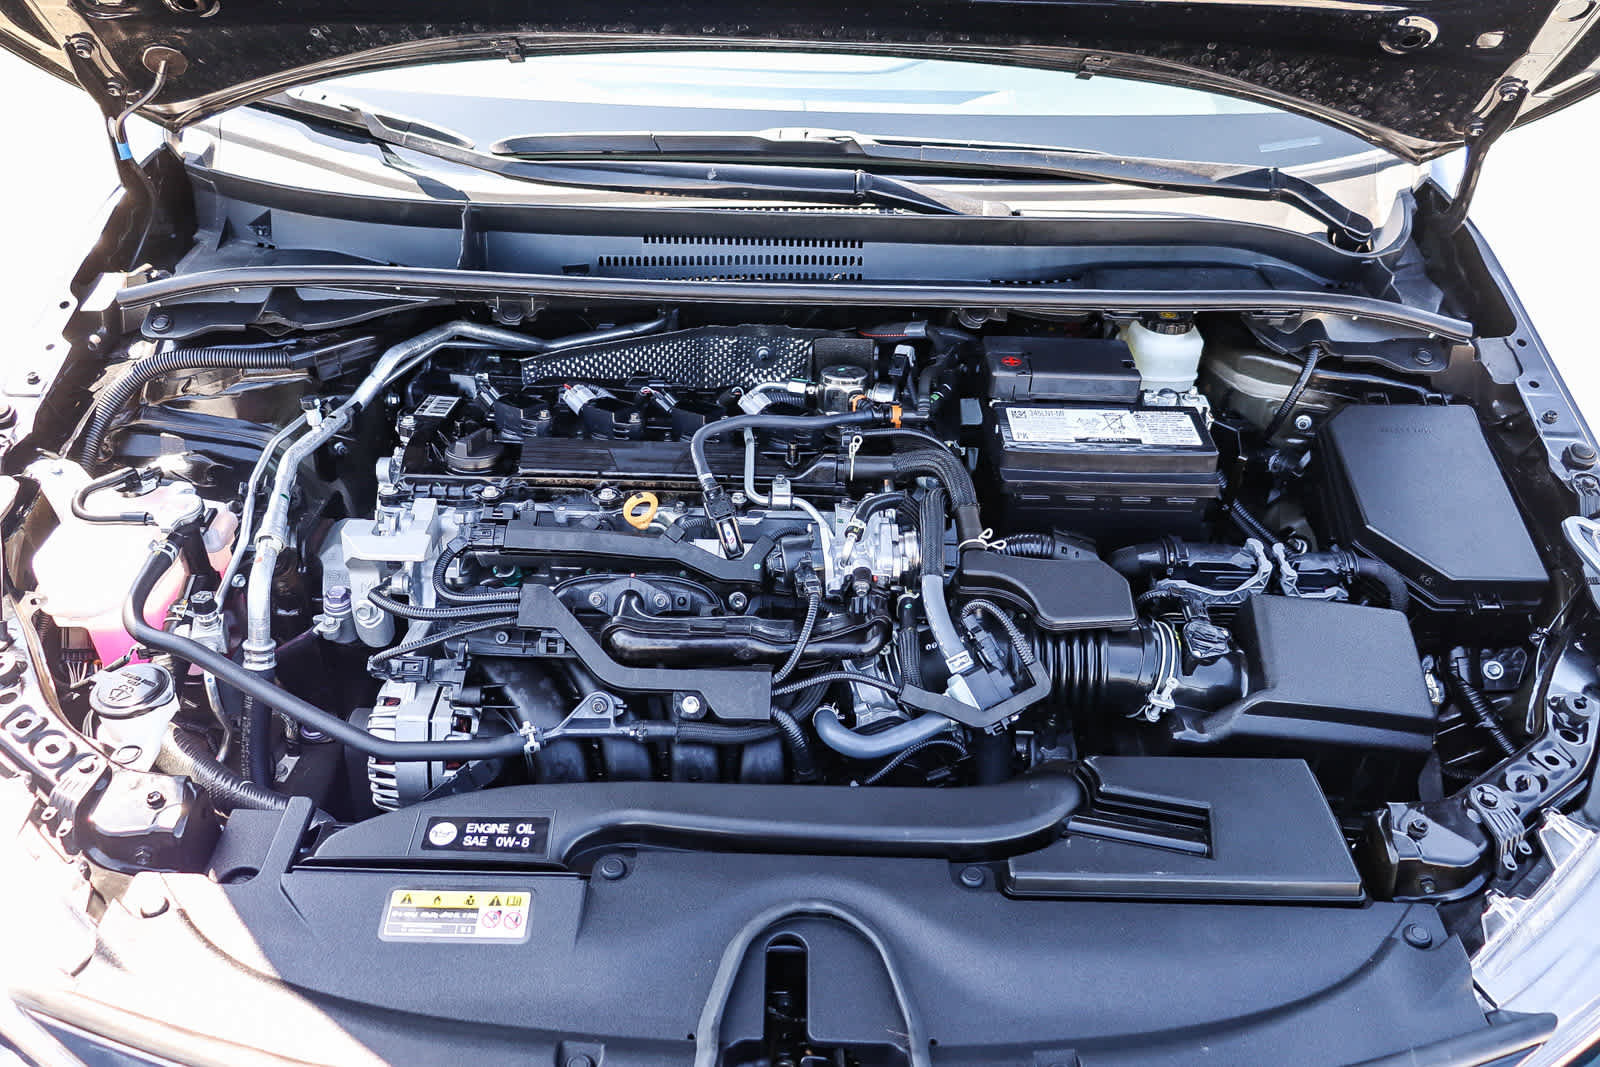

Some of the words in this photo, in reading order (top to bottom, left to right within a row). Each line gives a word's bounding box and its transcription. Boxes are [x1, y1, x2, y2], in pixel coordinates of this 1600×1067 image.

[465, 822, 510, 834] ENGINE
[516, 823, 536, 835] OIL
[462, 835, 489, 847] SAE
[495, 836, 530, 848] 0W-8
